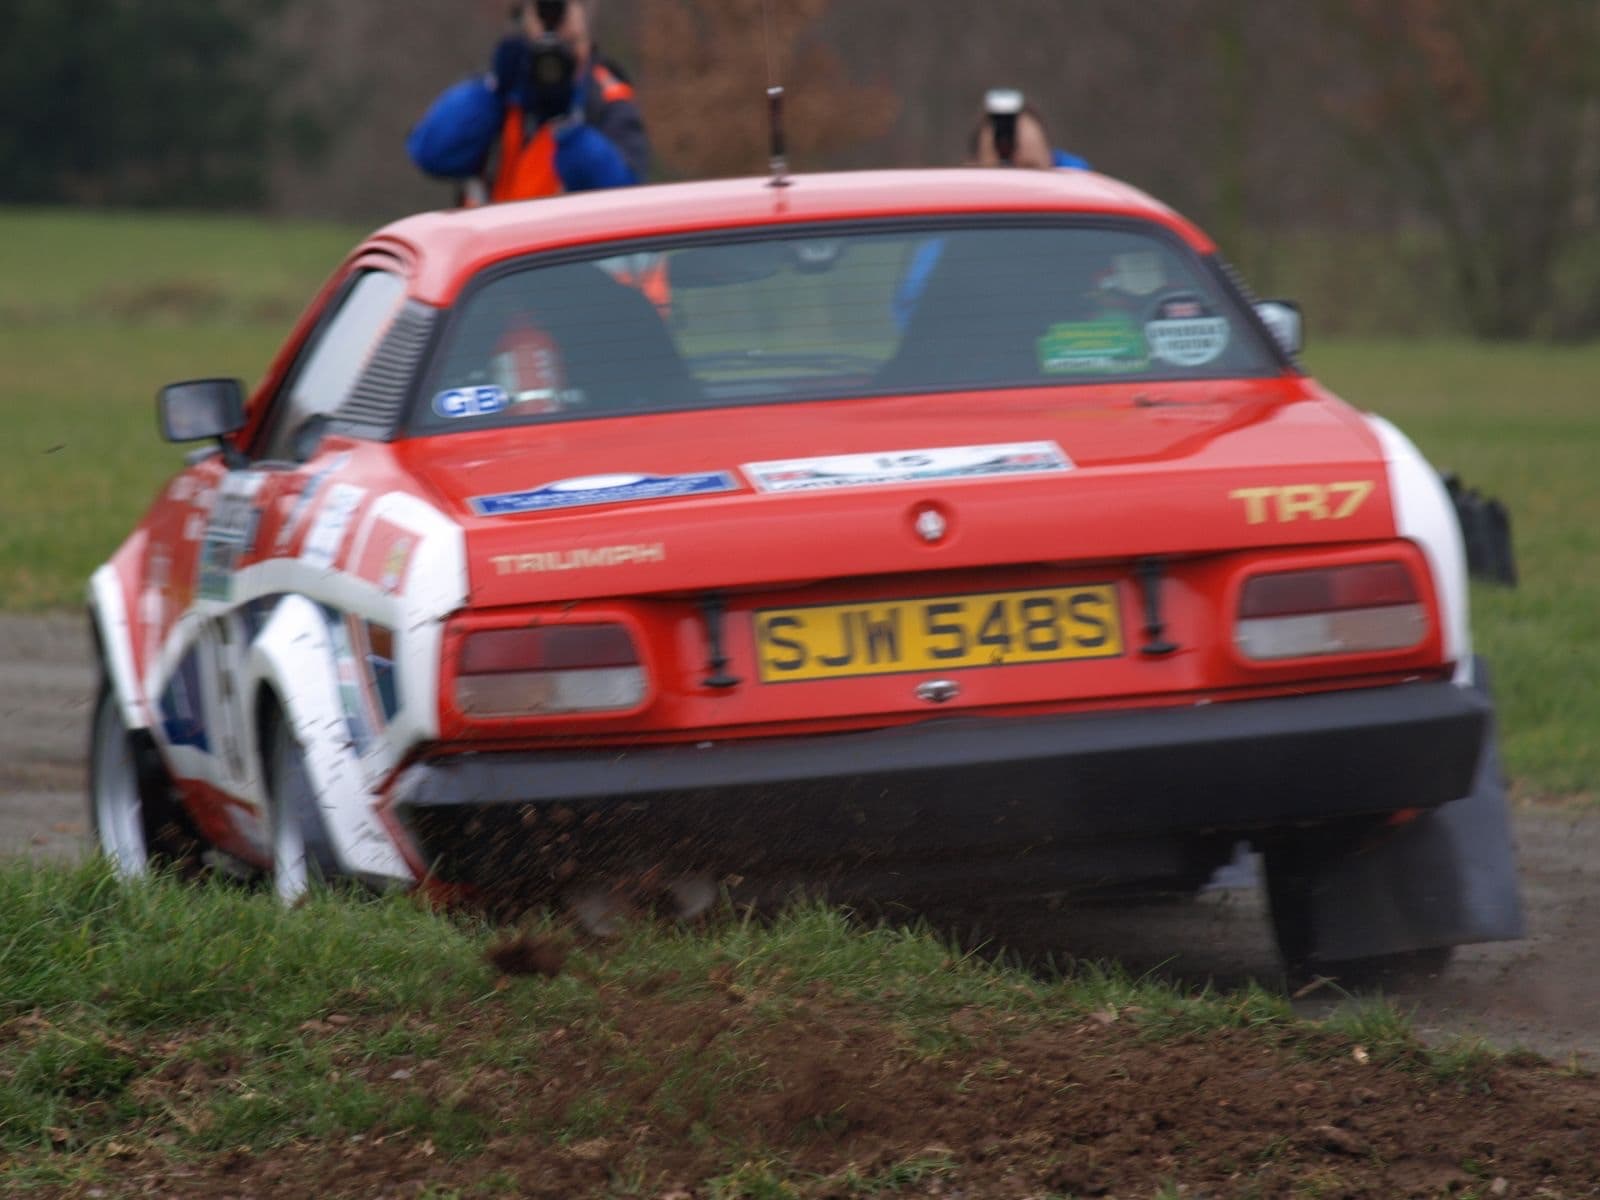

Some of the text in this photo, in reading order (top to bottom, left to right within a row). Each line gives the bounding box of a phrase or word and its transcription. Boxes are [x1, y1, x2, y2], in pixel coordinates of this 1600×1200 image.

[443, 387, 500, 415] GB
[1230, 481, 1373, 524] TR7
[490, 543, 664, 574] TRIUMPH
[764, 593, 1108, 671] SJW 548S
